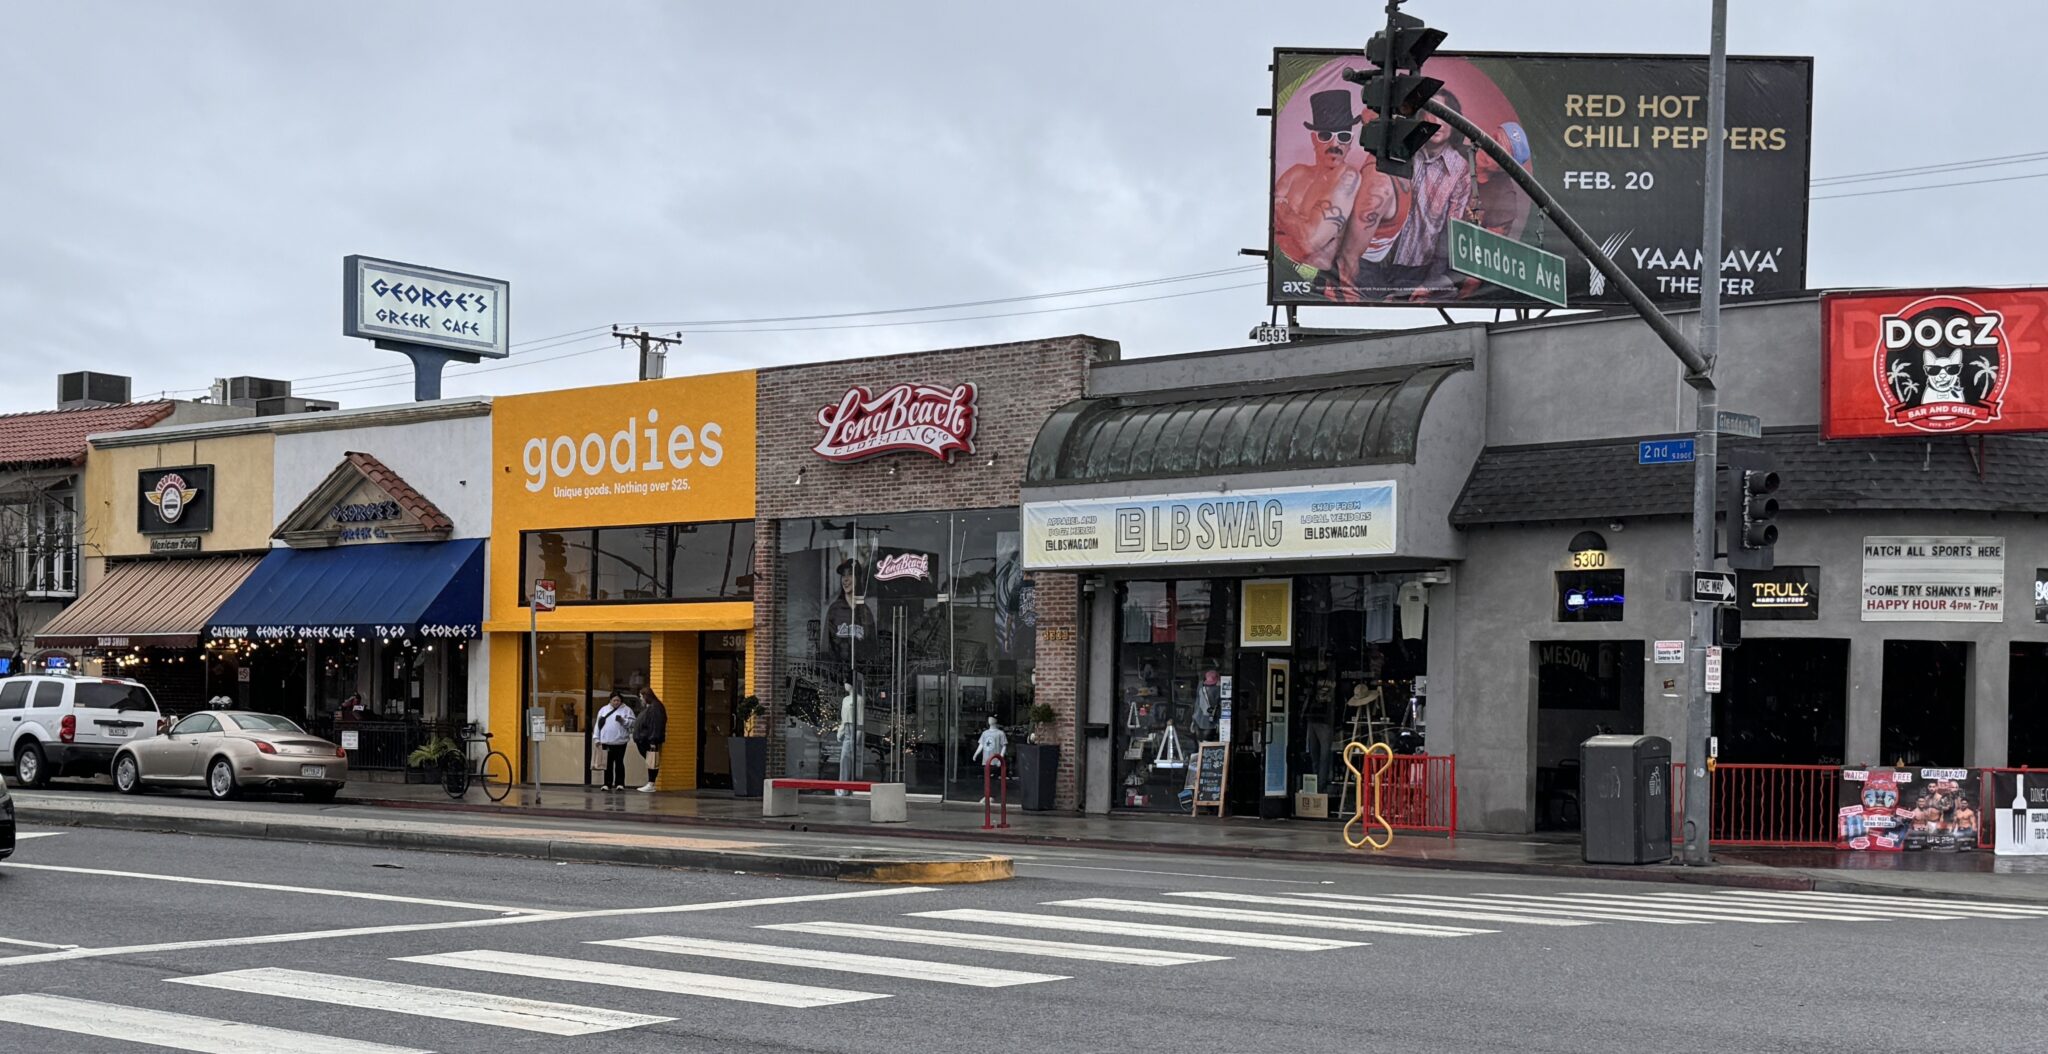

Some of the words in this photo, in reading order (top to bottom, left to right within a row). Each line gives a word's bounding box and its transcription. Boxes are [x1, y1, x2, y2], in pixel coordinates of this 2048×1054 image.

[1565, 94, 1626, 117] RED
[1637, 95, 1701, 118] HOT
[1563, 125, 1640, 148] CHILI
[1651, 126, 1787, 151] PEPERS
[1563, 171, 1616, 189] FEB.
[1625, 171, 1654, 190] 20
[1458, 233, 1526, 280] Glendora
[1535, 263, 1561, 292] Ave
[1656, 276, 1755, 295] THETER
[371, 278, 488, 313] GEORGE'S
[375, 308, 431, 329] GREEK
[441, 318, 480, 336] CAFE
[1259, 329, 1287, 342] 6593
[1885, 316, 2000, 349] DOGZ
[1908, 408, 1927, 419] BAR
[1929, 405, 1949, 415] AND
[1951, 406, 1978, 417] GRILL
[833, 427, 937, 455] CLOTHING
[523, 408, 724, 492] goodies
[1644, 444, 1668, 458] 2nd
[553, 485, 583, 499] Unique
[584, 482, 612, 499] goods.
[614, 478, 648, 496] Nothing
[650, 480, 669, 492] over
[671, 478, 691, 492] $25.
[1311, 502, 1335, 512] SHOP
[1336, 500, 1362, 511] FROM
[1301, 513, 1329, 524] LOCAL
[1330, 511, 1372, 522] VENDORS
[1151, 505, 1191, 552] LB
[1196, 499, 1283, 550] SWAG
[1865, 545, 1902, 556] WATCH
[1906, 545, 1926, 556] ALL
[1931, 545, 1972, 557] SPORTS
[1978, 546, 2001, 557] HERE
[1573, 552, 1605, 567] 5300
[1698, 580, 1711, 592] ONE
[1752, 583, 1808, 596] TRULY
[1901, 585, 1923, 596] TRY
[1925, 586, 1971, 597] SHANKYS
[1867, 600, 1909, 610] HAPPY
[1912, 600, 1946, 610] HOUR
[210, 625, 249, 638] CATERING
[256, 625, 295, 638] GEORGE'S
[298, 626, 331, 638] GREEK
[332, 625, 355, 638] CAFE
[375, 625, 388, 637] TO
[389, 625, 406, 638] GO
[420, 624, 477, 638] GEORGE'S
[722, 634, 746, 647] 530
[1893, 773, 1912, 782] FREE
[1922, 769, 1953, 779] SATURDAY
